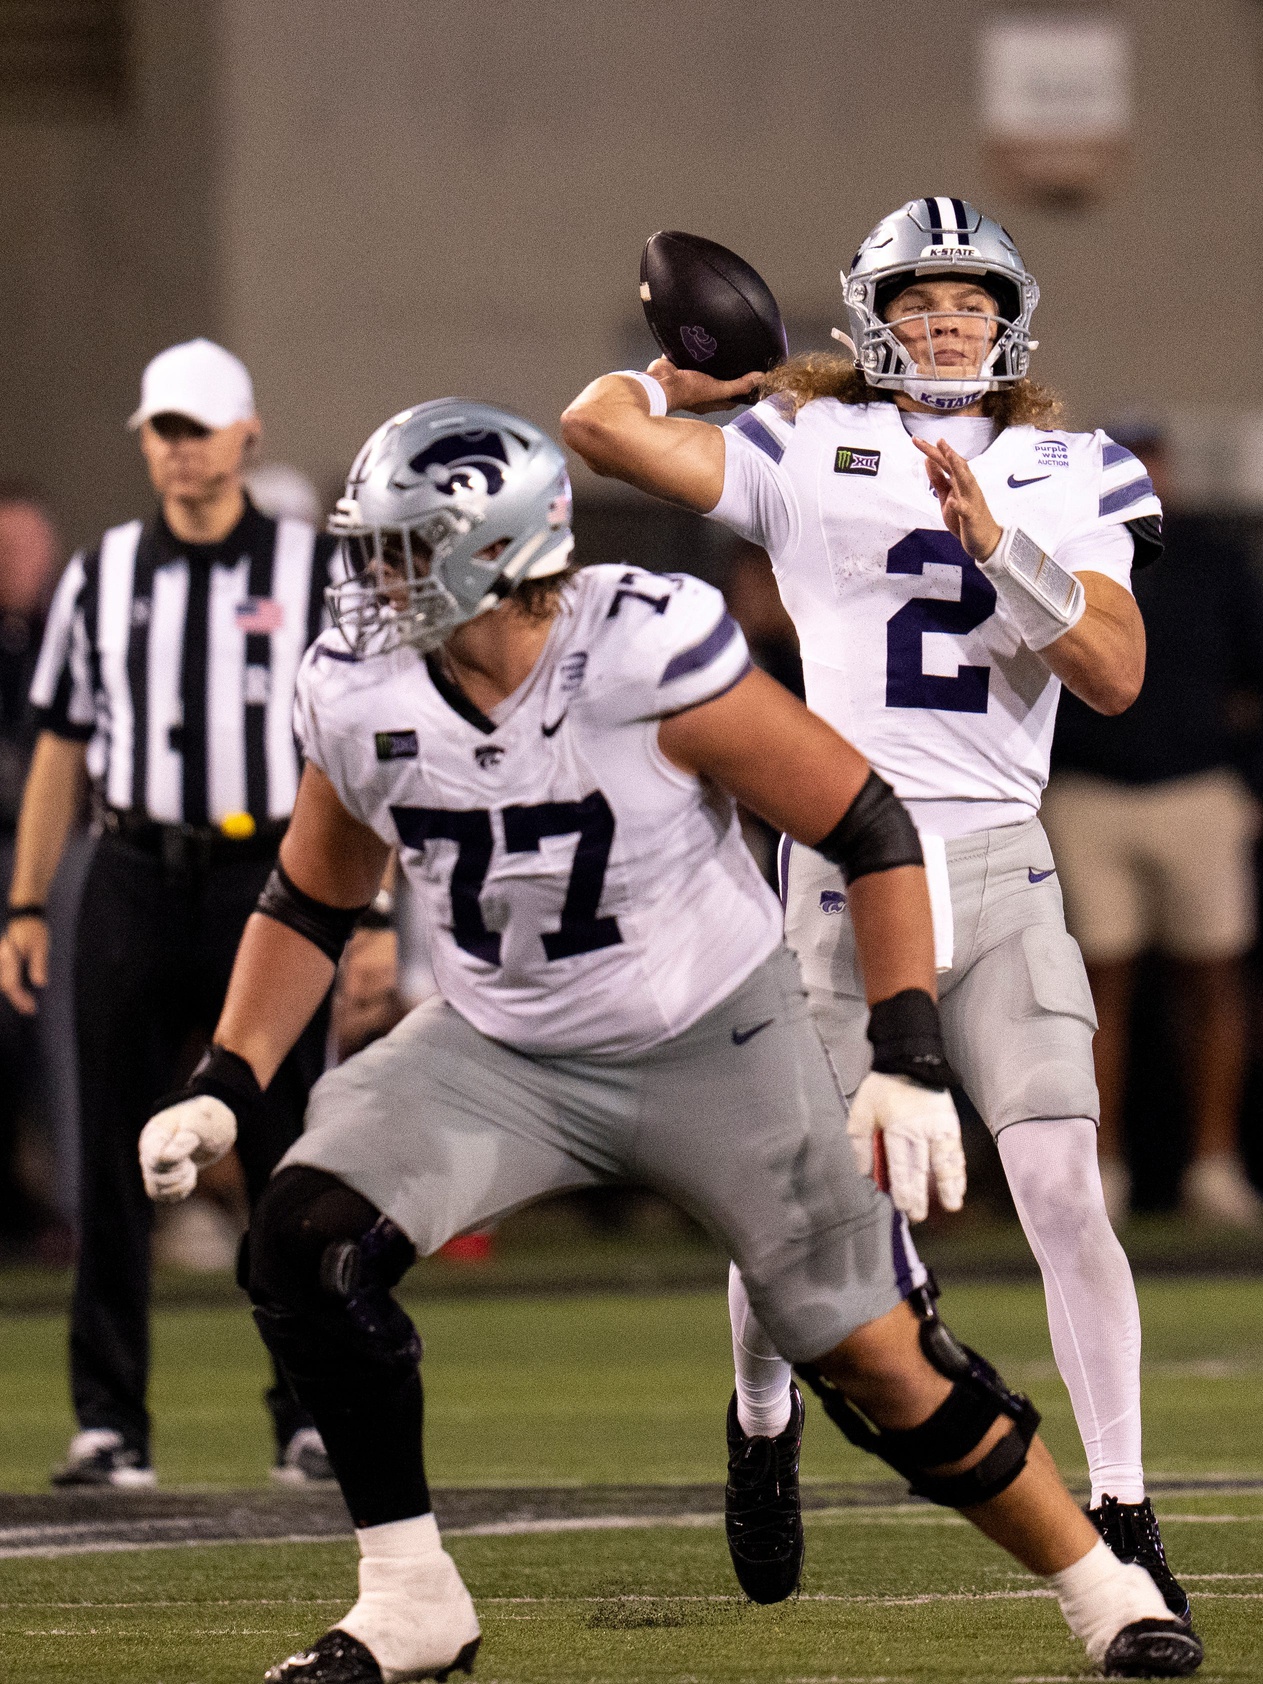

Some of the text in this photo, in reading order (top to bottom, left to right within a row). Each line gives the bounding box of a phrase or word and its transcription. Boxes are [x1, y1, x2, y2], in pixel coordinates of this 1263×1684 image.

[930, 248, 975, 256] K-STATE
[920, 390, 983, 408] K-STATE
[1034, 445, 1067, 453] purple
[1037, 459, 1069, 467] AUCTION
[885, 528, 997, 714] 2
[388, 789, 624, 966] 77
